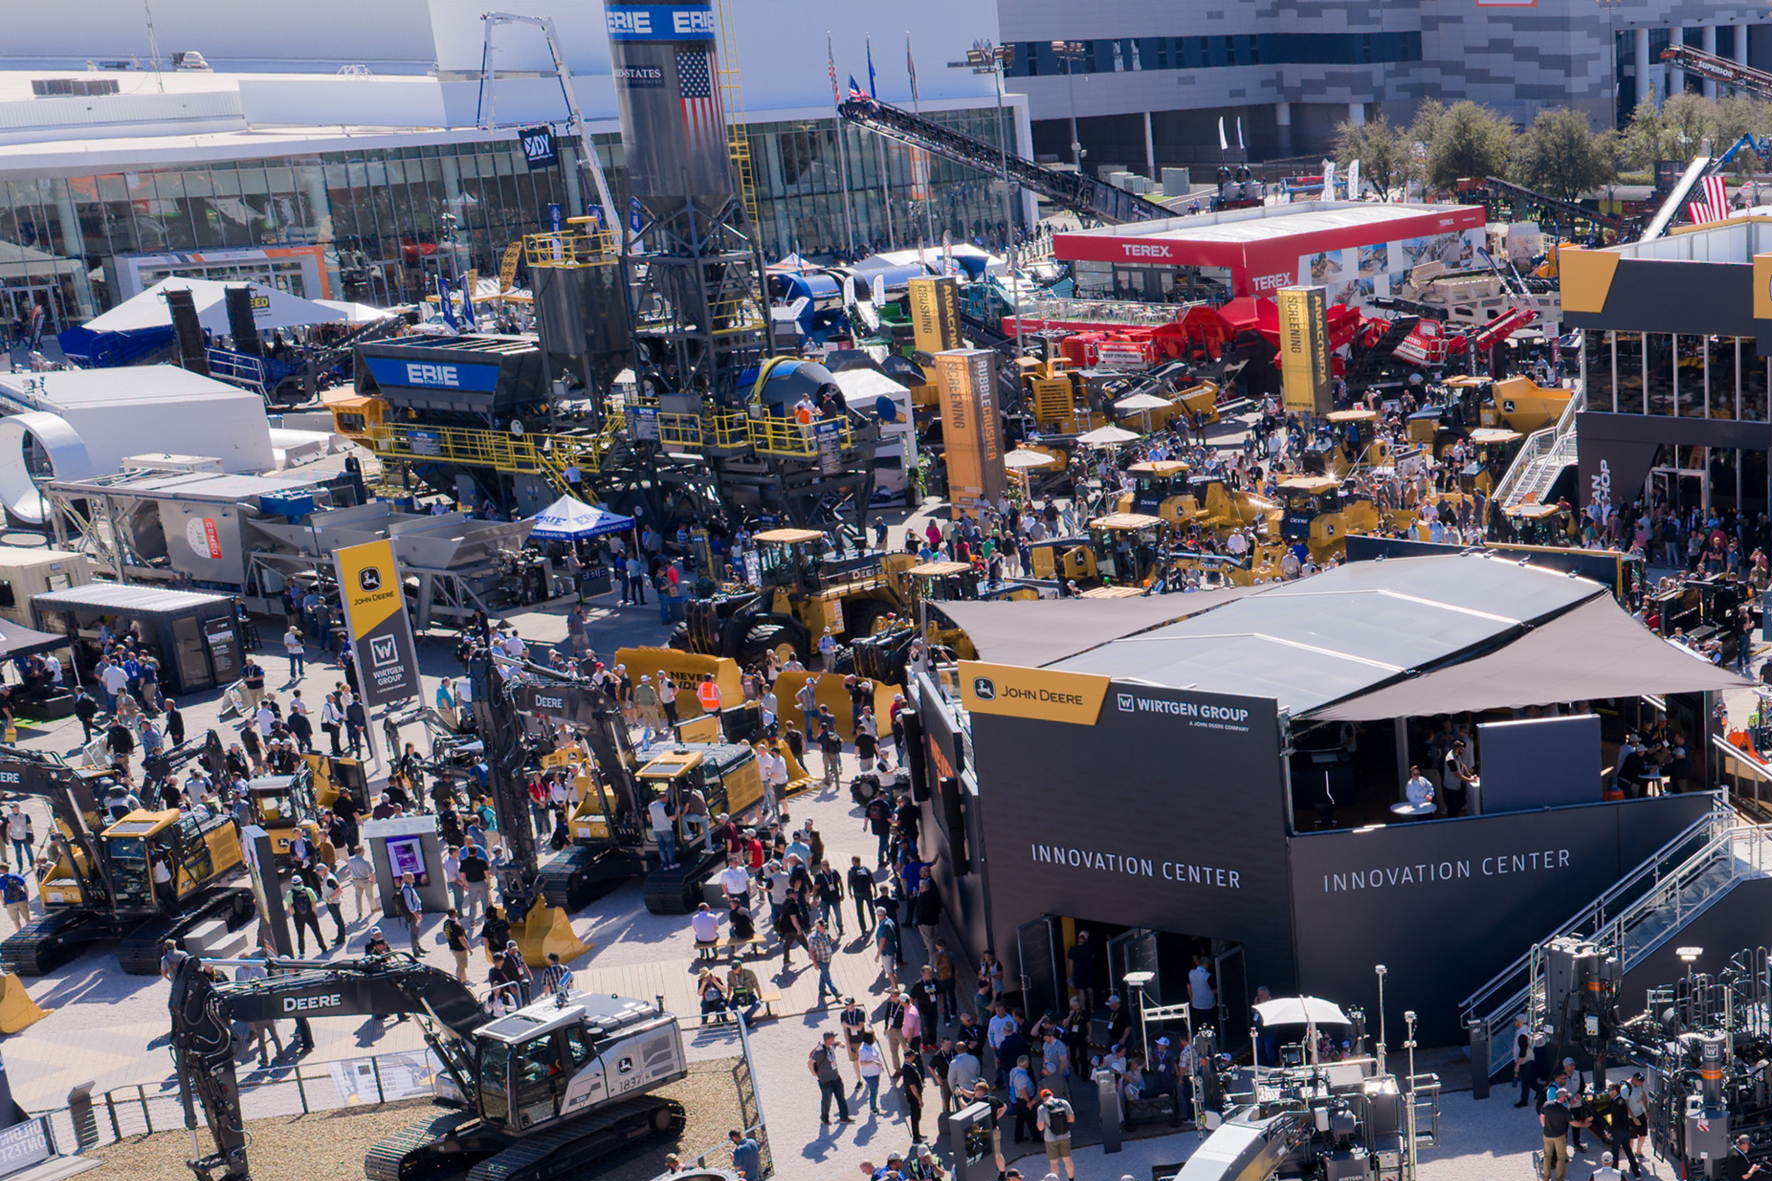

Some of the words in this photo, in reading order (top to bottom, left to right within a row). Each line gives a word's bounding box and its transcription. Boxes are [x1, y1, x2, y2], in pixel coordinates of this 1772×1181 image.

[608, 11, 652, 34] ERIE
[1698, 61, 1734, 78] SUPERIOR
[1122, 244, 1171, 258] TEREX
[1252, 272, 1293, 291] TEREX
[917, 285, 934, 334] CRUSHING
[943, 284, 959, 349] ANACON
[1287, 296, 1302, 354] SCREENING
[1314, 295, 1327, 385] ANACONDA
[406, 364, 460, 386] ERIE
[947, 361, 966, 429] SCREENING
[1591, 475, 1601, 503] AN
[205, 521, 219, 556] CEMCO
[354, 595, 372, 606] JOHN
[372, 590, 395, 601] DEERE
[373, 665, 404, 680] WIRTGEN
[378, 674, 403, 686] GROUP
[671, 671, 706, 682] NEVE
[679, 681, 698, 691] IDL
[1001, 685, 1037, 700] JOHN
[1039, 689, 1084, 706] DEERE
[535, 694, 563, 709] DEERE
[1137, 698, 1198, 716] WIRTGEN
[1200, 704, 1249, 722] GROUP
[1225, 724, 1249, 732] COMPANY
[169, 755, 187, 768] DEERE
[0, 771, 20, 784] ERE
[1031, 844, 1153, 877] INNOVATION
[1163, 862, 1241, 889] CENTER
[1324, 860, 1471, 892] INNOVATION
[1482, 849, 1570, 876] CENTER
[283, 994, 341, 1013] DEERE
[619, 1076, 642, 1093] 1837
